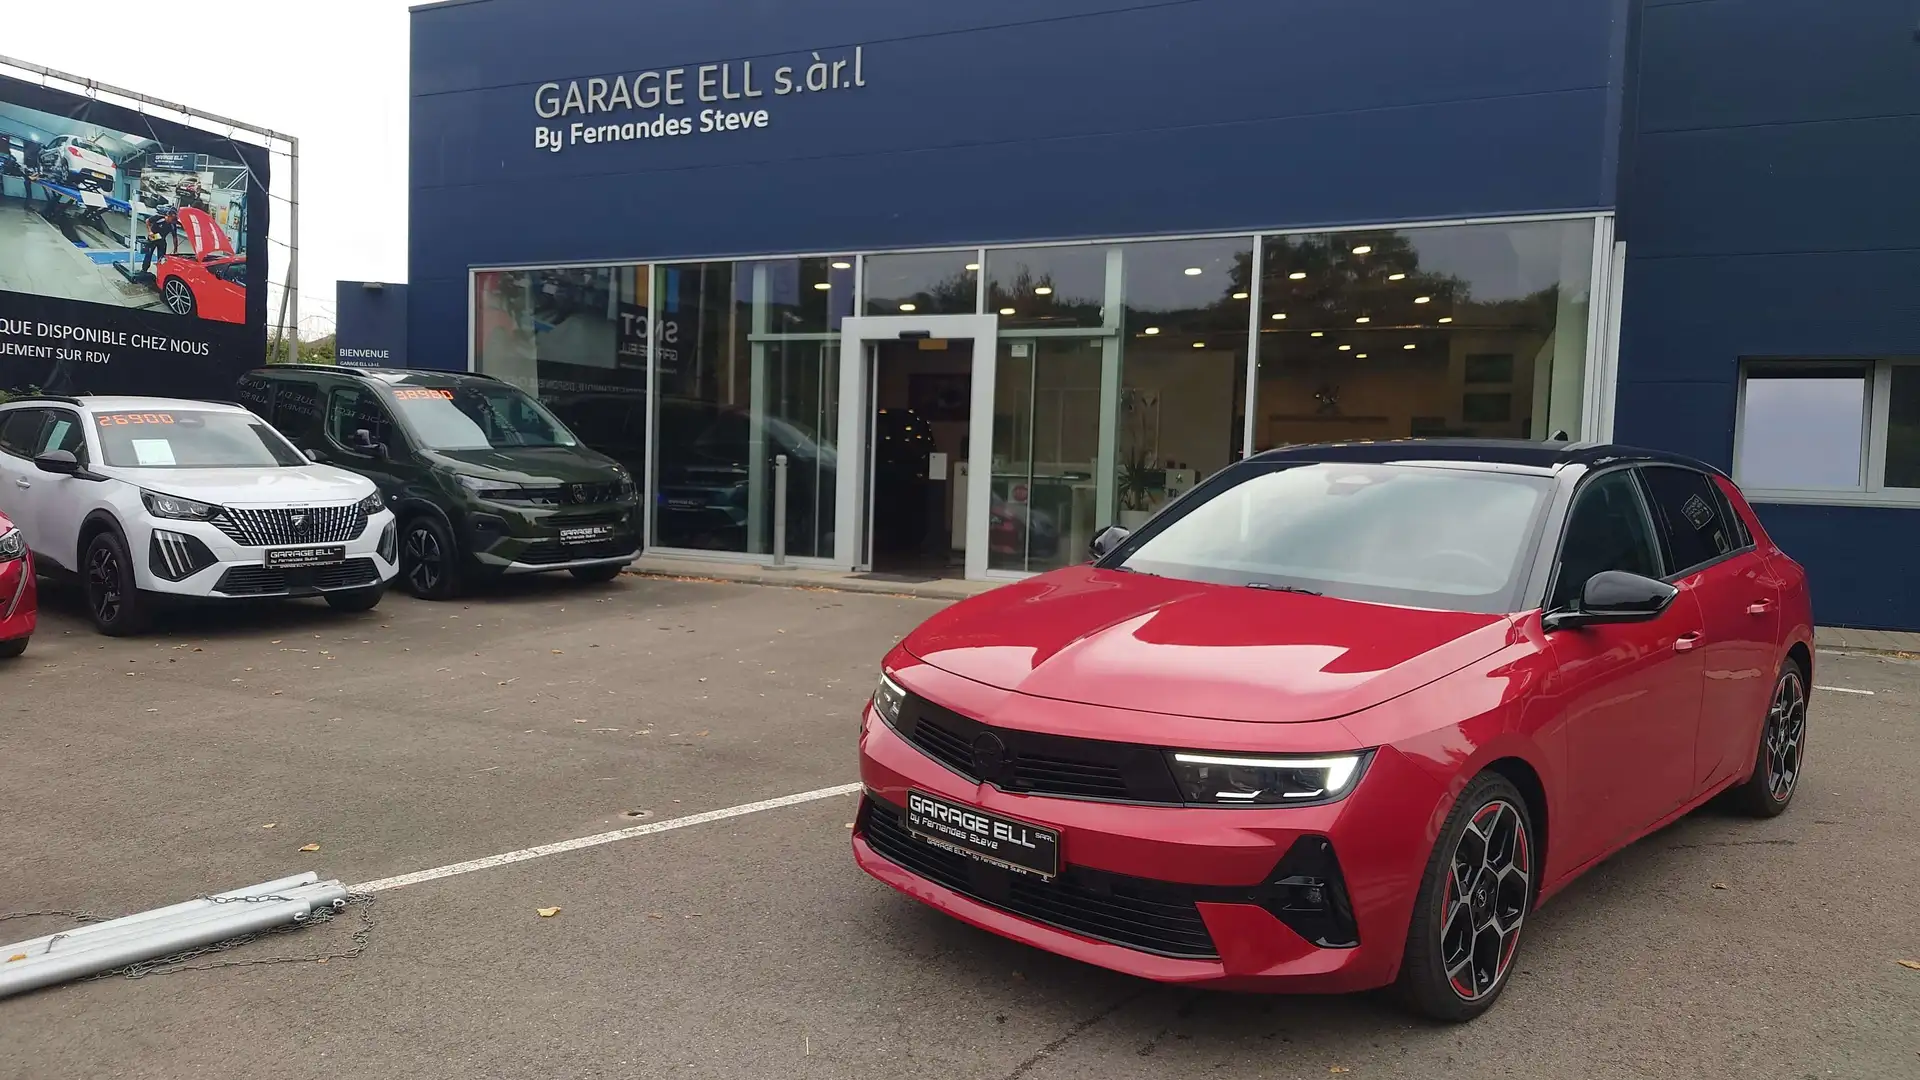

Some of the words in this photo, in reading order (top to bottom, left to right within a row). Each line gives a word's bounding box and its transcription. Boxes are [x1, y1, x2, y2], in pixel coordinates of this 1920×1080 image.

[534, 68, 684, 119] GARAGE
[698, 61, 762, 102] ELL
[774, 46, 866, 95] s.àr.l
[535, 126, 562, 152] By
[570, 113, 692, 145] Fernandes
[699, 108, 769, 134] Steve
[0, 318, 32, 336] QUE
[37, 322, 127, 346] DISPONIBLE
[131, 334, 167, 351] CHEZ
[170, 339, 209, 356] NOUS
[56, 348, 82, 361] SUR
[85, 351, 110, 364] RDV
[339, 348, 389, 359] BIENVENUE
[97, 413, 175, 427] 26900
[270, 549, 314, 559] GARAGE
[315, 548, 334, 556] ELL
[909, 795, 989, 836] GARAGE
[993, 821, 1036, 849] ELL
[1035, 832, 1055, 843] SARL
[909, 812, 920, 825] by
[921, 814, 967, 840] Fernandes
[969, 833, 999, 850] Steve
[926, 837, 953, 852] GARAGE
[953, 846, 967, 857] ELL
[972, 854, 980, 862] by
[980, 855, 1009, 870] Fernandes
[1009, 865, 1027, 875] Steve
